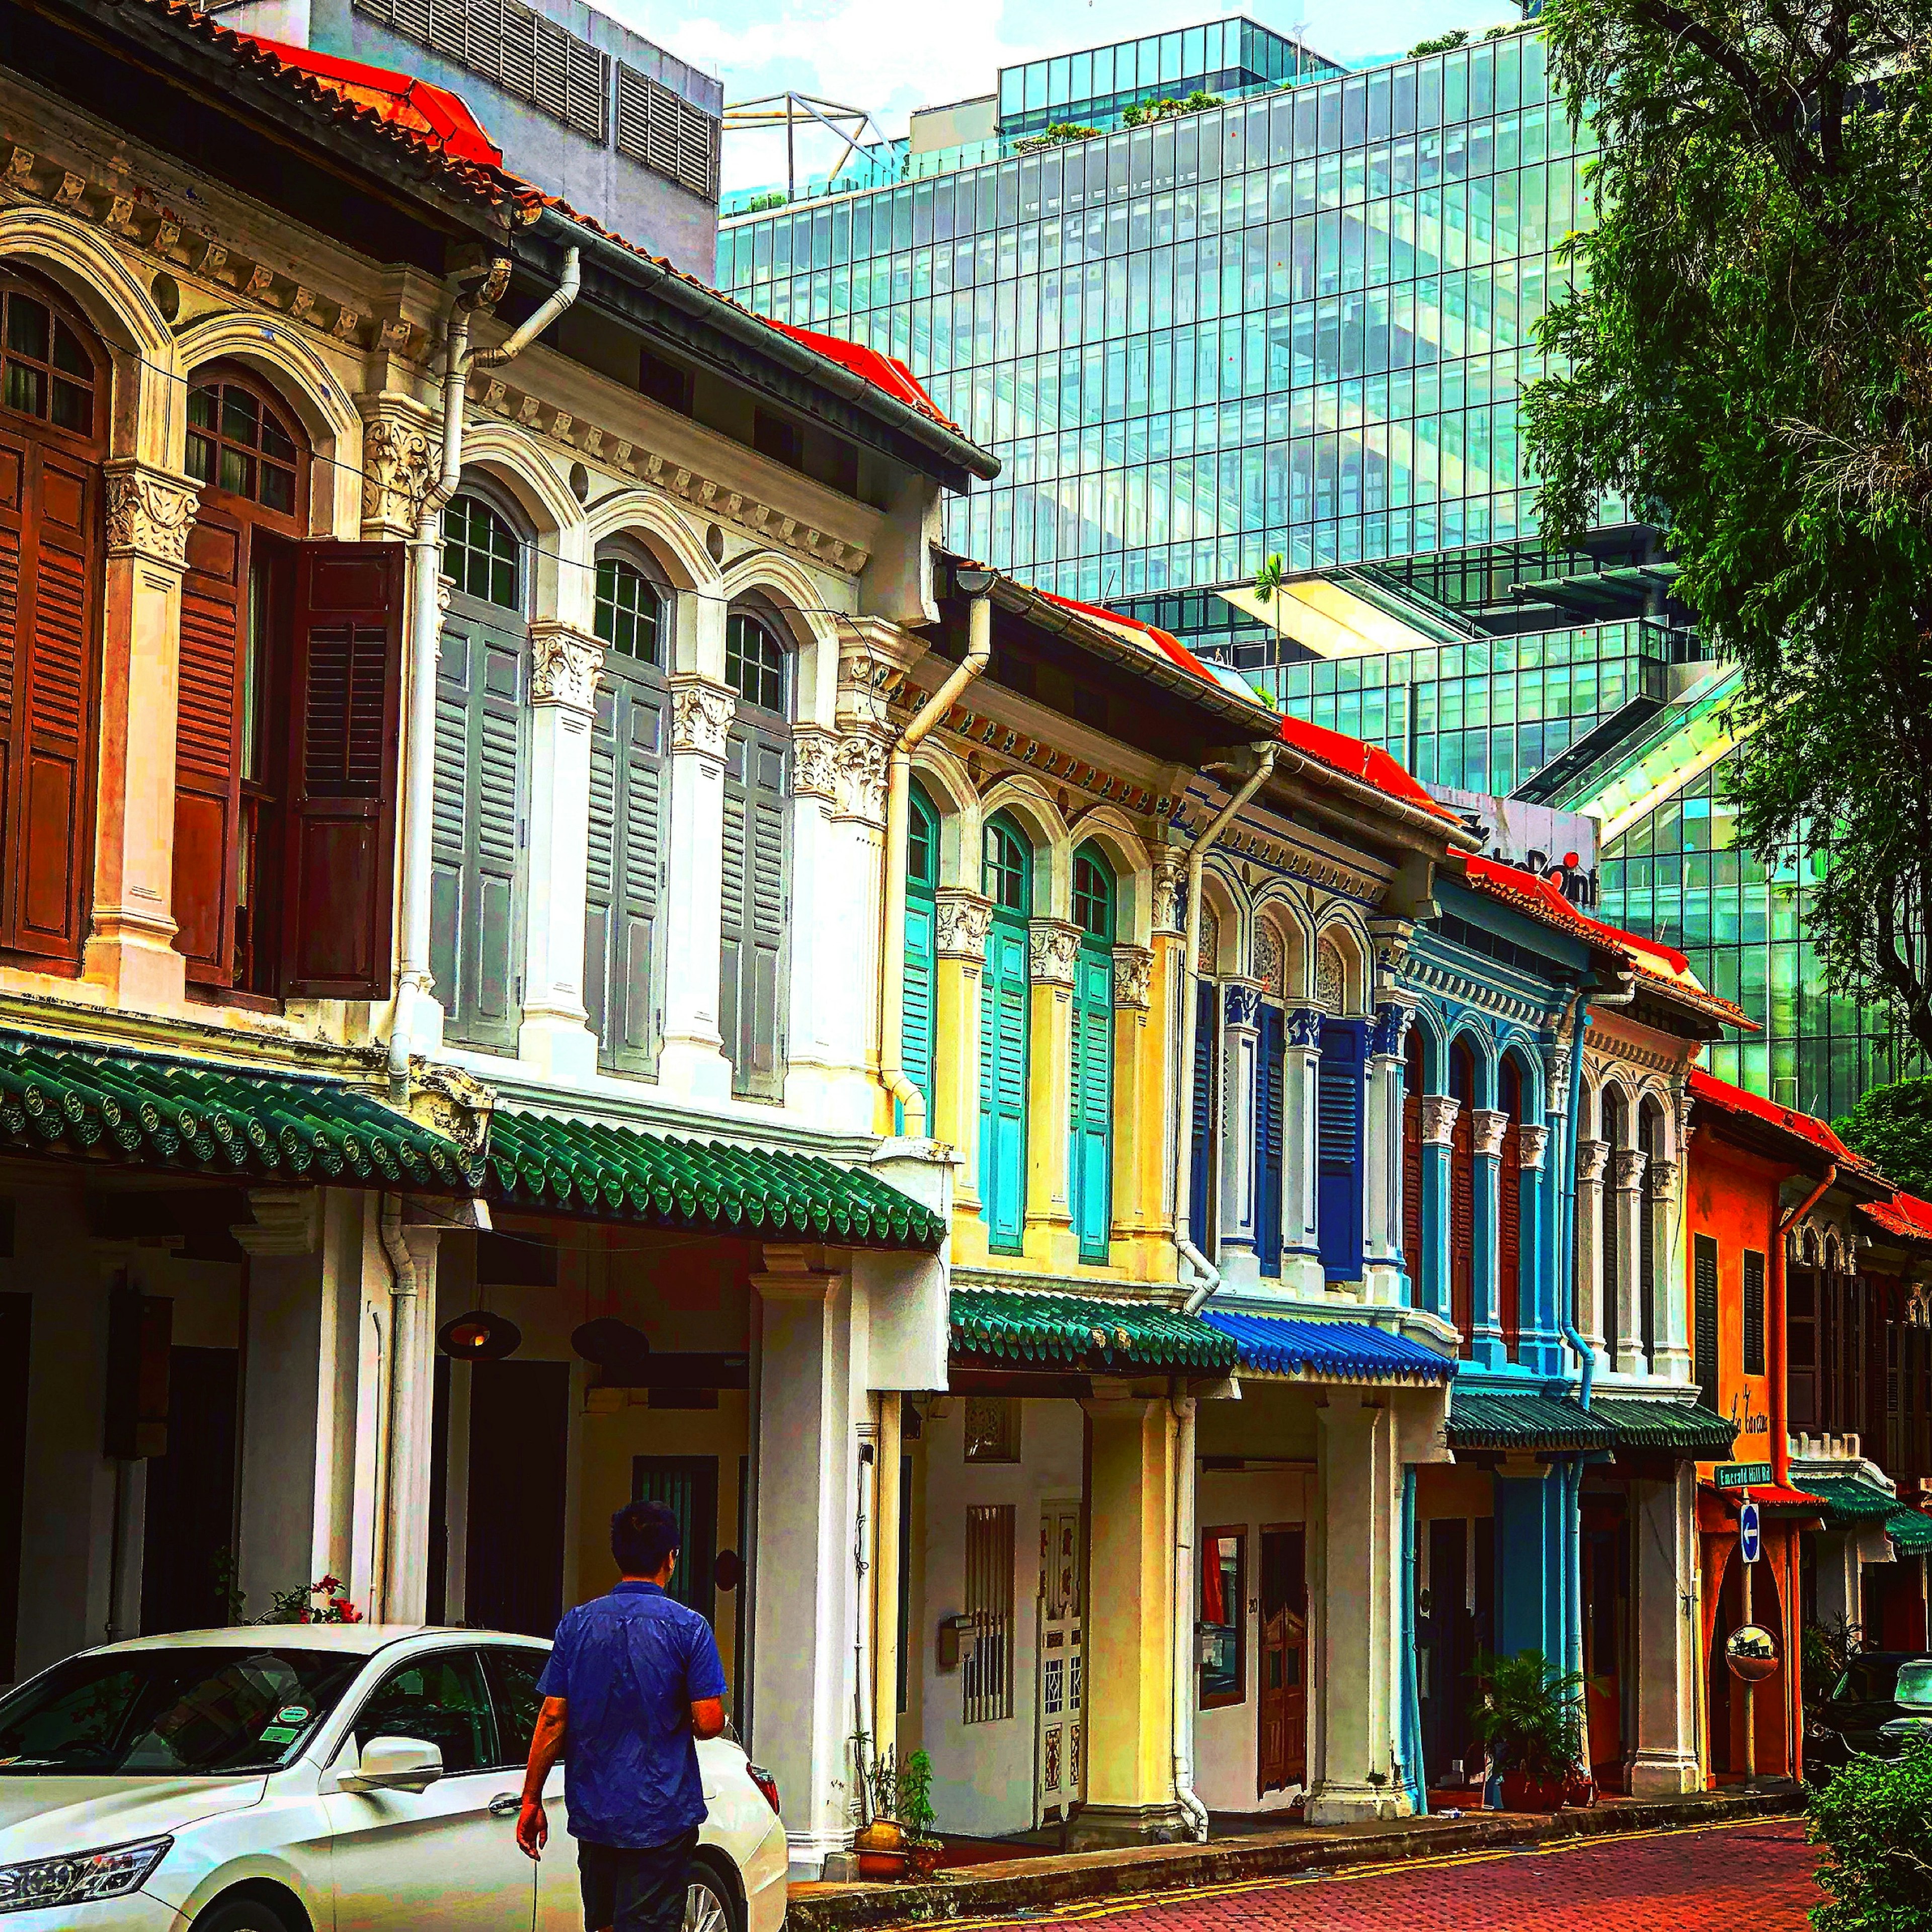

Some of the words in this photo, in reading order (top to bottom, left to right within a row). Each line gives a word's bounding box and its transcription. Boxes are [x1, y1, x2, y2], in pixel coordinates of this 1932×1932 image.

[1720, 1468, 1748, 1485] Emerald
[1748, 1467, 1761, 1482] Hill
[1761, 1466, 1770, 1481] Rd
